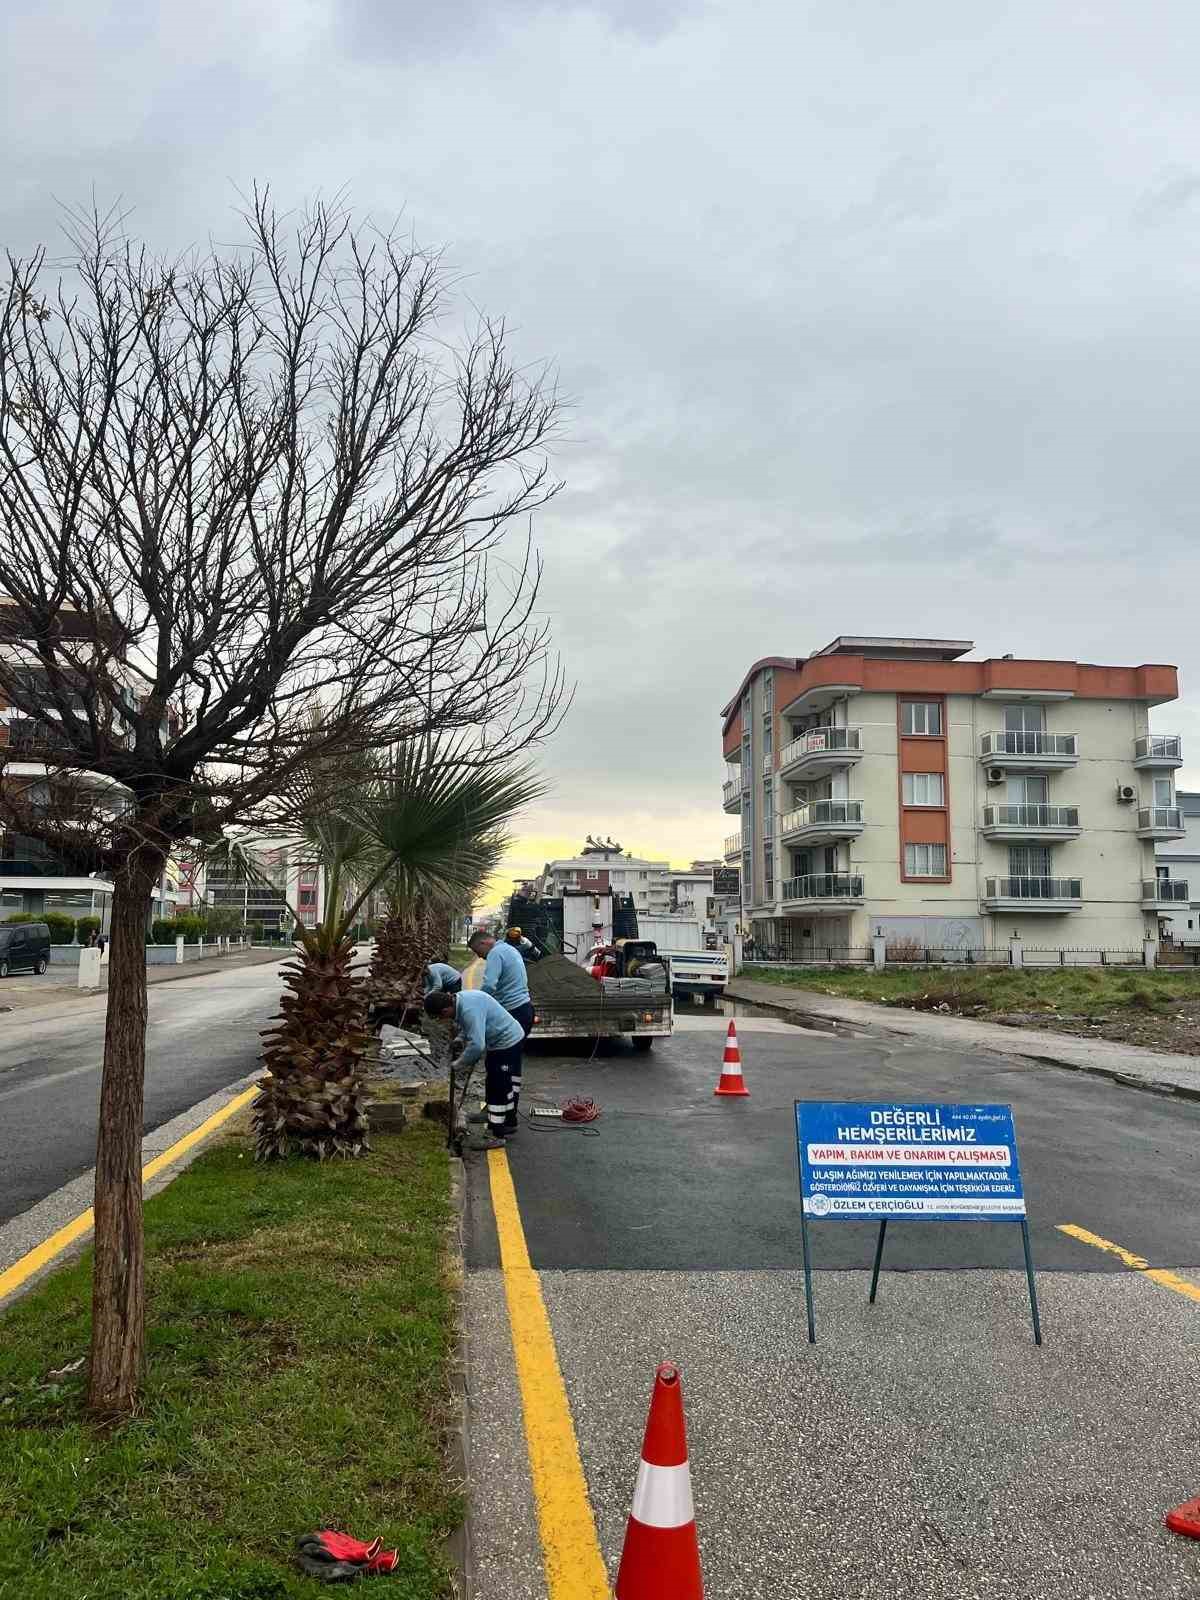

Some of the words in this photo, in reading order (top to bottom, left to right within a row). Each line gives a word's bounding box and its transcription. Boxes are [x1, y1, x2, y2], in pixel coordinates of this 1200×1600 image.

[870, 1107, 941, 1125] DEĞERLİ
[837, 1125, 976, 1144] HEMŞERİLERİMİZ
[812, 1149, 848, 1161] YAPIM,
[850, 1150, 884, 1161] BAKIM
[886, 1150, 901, 1160] VE
[903, 1150, 946, 1161] ONARIM
[948, 1150, 1007, 1163] ÇALIŞMASI
[812, 1170, 844, 1182] ULAŞIM
[846, 1168, 877, 1180] AĞIMIZI
[878, 1169, 924, 1181] YENİLEMEK
[925, 1169, 942, 1182] İÇİN
[888, 1183, 899, 1192] VE
[940, 1182, 955, 1194] İÇİN
[833, 1199, 866, 1210] ÖZLEM
[868, 1199, 924, 1212] ÇERÇİOĞLU
